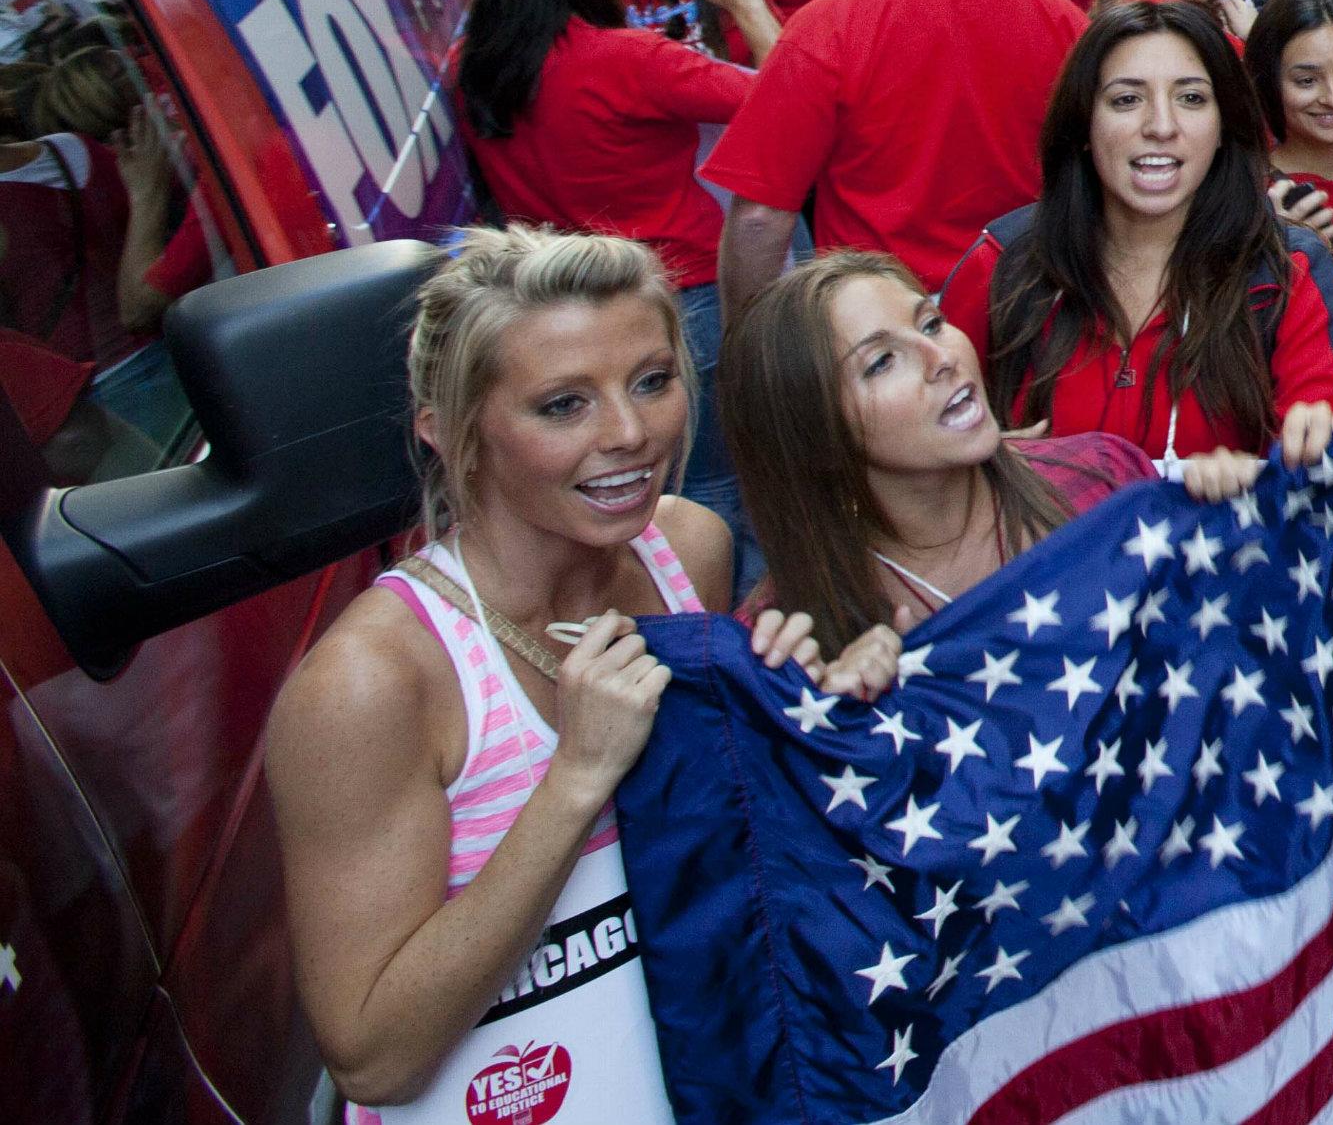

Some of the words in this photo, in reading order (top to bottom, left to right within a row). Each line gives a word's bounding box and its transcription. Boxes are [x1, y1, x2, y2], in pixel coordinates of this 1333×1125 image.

[470, 1064, 523, 1102] YES
[470, 1100, 487, 1117] TO
[488, 1071, 568, 1110] EDUCATIONAL
[496, 1093, 546, 1120] JUSTICE
